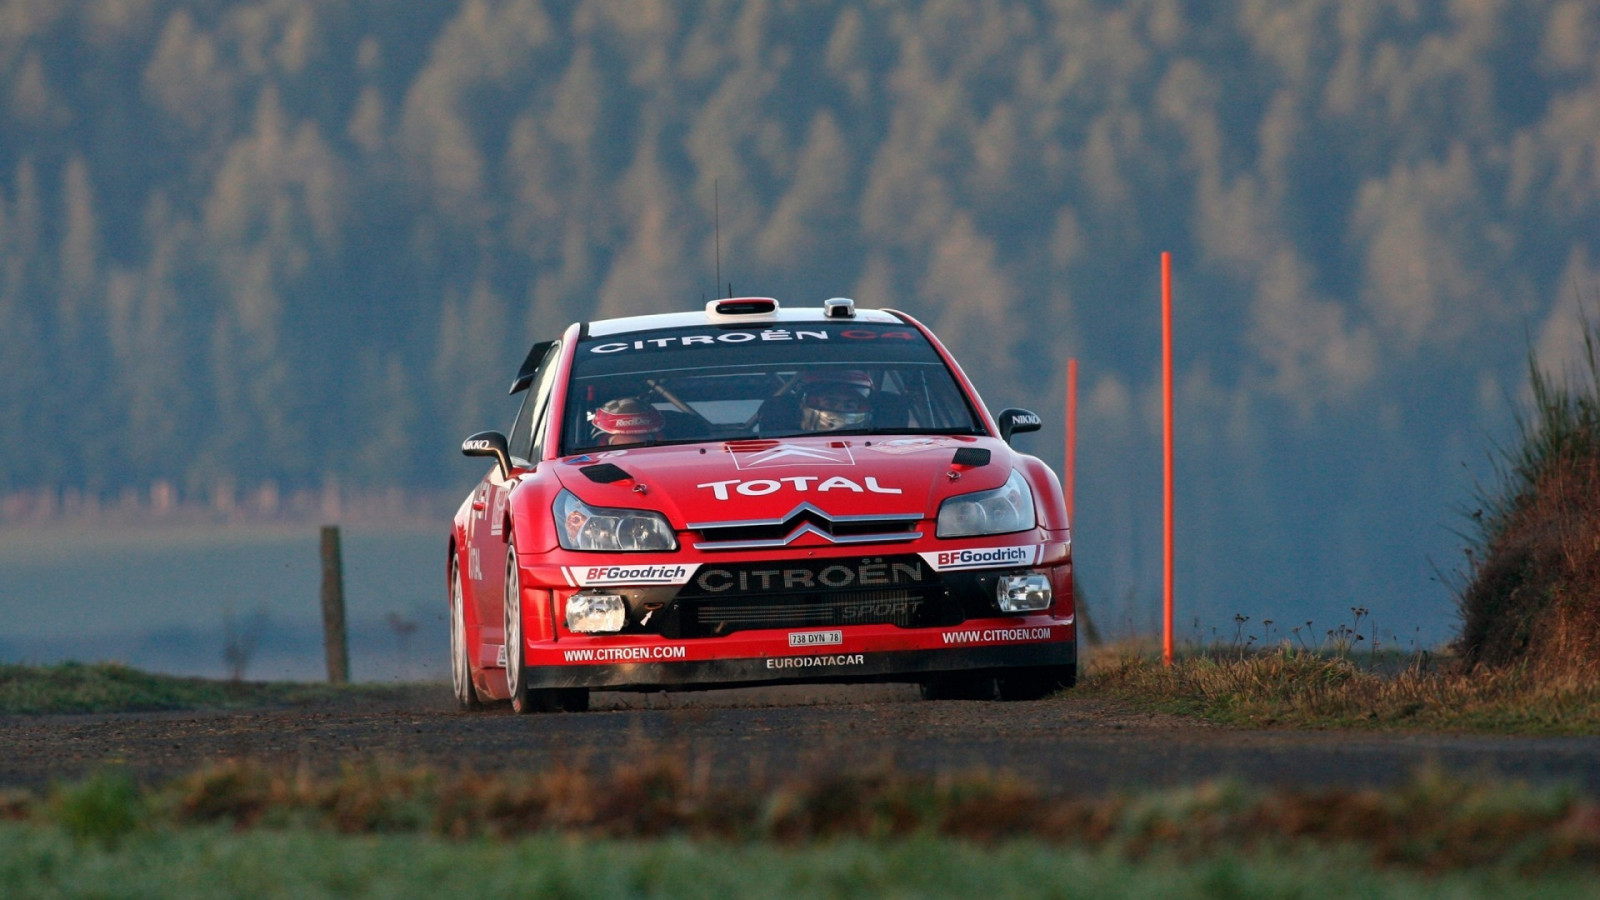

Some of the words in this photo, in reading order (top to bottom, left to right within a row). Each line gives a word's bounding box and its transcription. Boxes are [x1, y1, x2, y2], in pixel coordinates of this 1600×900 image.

[590, 329, 828, 354] CITROËN
[840, 330, 914, 341] C4
[697, 476, 903, 500] TOTAL
[938, 547, 1027, 564] BFGoodrich
[586, 566, 686, 580] BFGoodrich
[697, 558, 923, 592] CITROËN
[842, 600, 923, 618] SPORT
[792, 634, 806, 645] 738
[808, 633, 825, 644] DYN
[829, 632, 840, 642] 78
[942, 628, 1051, 644] WWW.CITROEN.COM
[564, 646, 686, 662] WWW.CITROEN.COM
[766, 655, 864, 669] EURODATACAR
